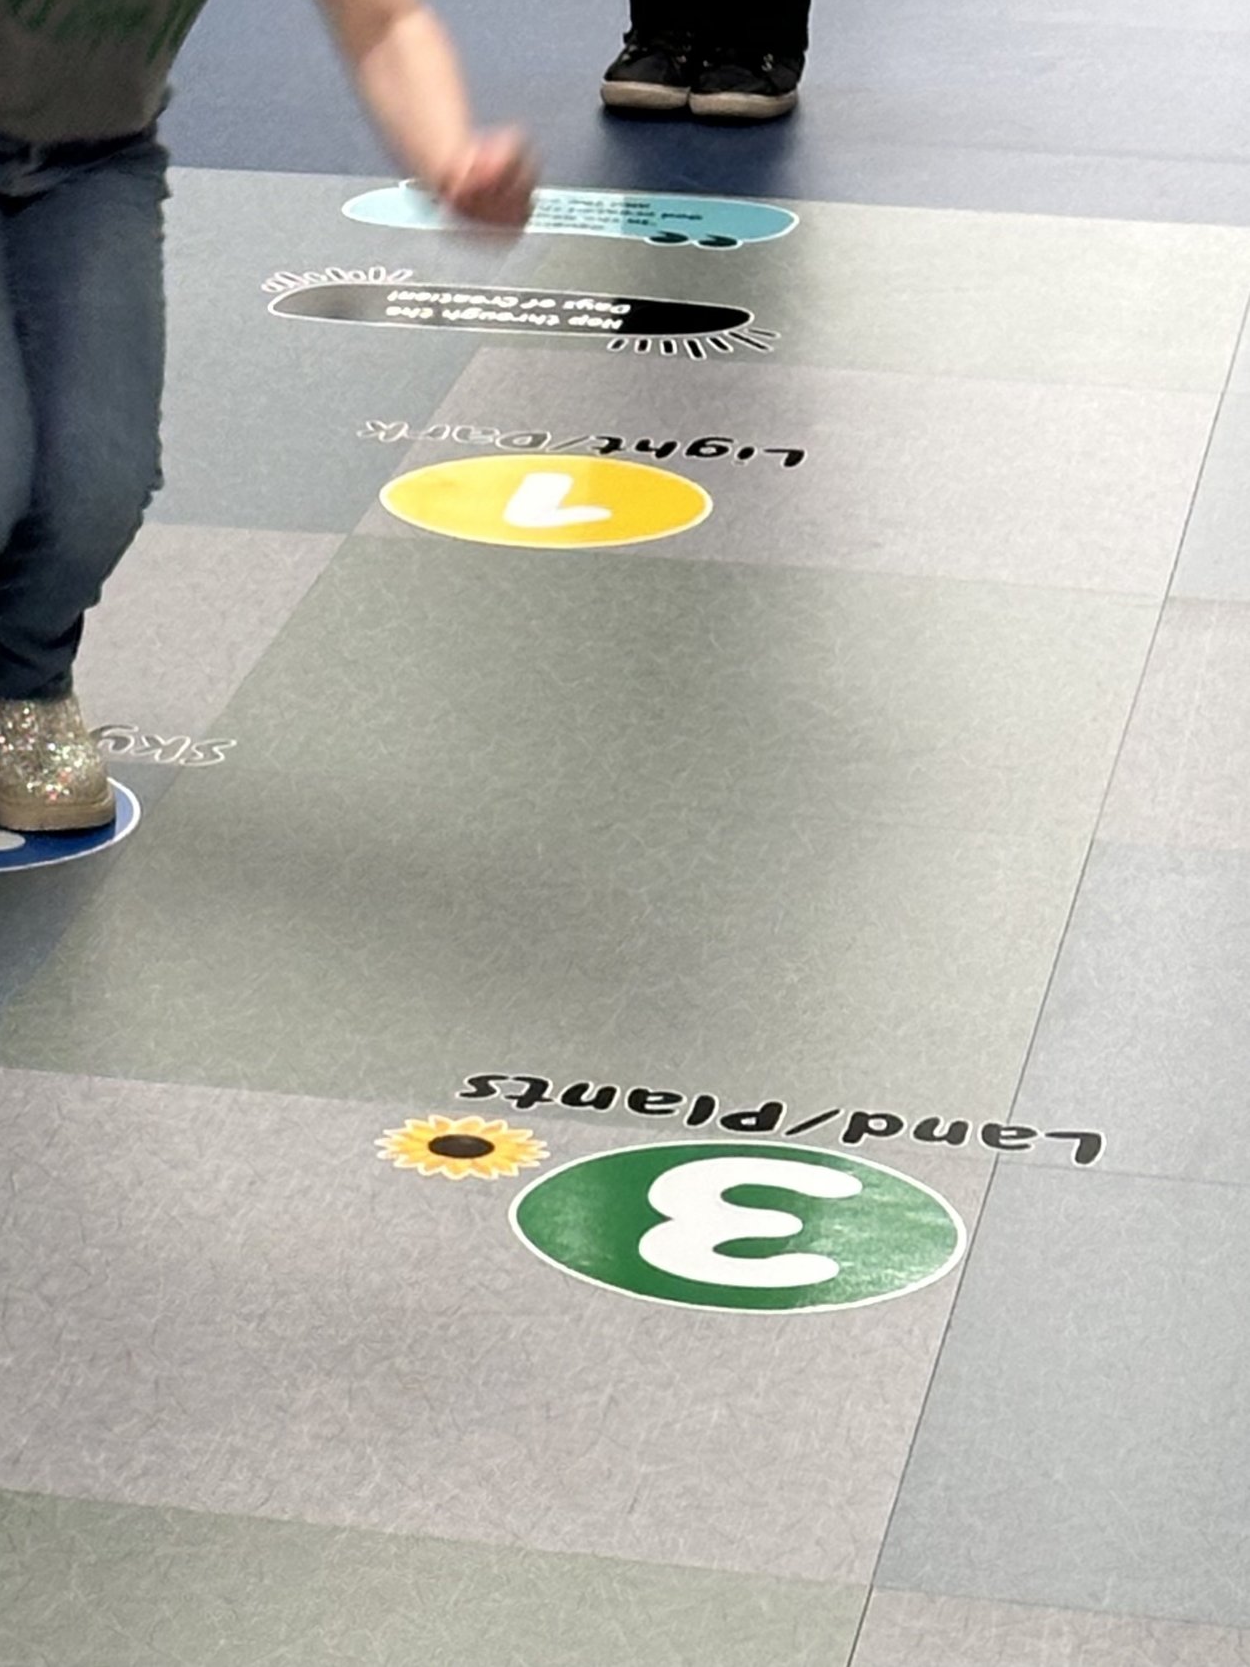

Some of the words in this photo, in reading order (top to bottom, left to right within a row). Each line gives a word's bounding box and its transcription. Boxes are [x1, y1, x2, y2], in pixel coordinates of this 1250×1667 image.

[386, 289, 520, 309] Creation!
[519, 297, 557, 310] of
[561, 297, 631, 315] Days
[384, 304, 434, 319] the
[441, 306, 561, 327] through
[566, 313, 623, 330] Hop
[356, 419, 808, 468] Light/Dark
[502, 472, 612, 528] 1
[455, 1073, 1105, 1166] Land/Plants
[638, 1156, 864, 1289] 3
